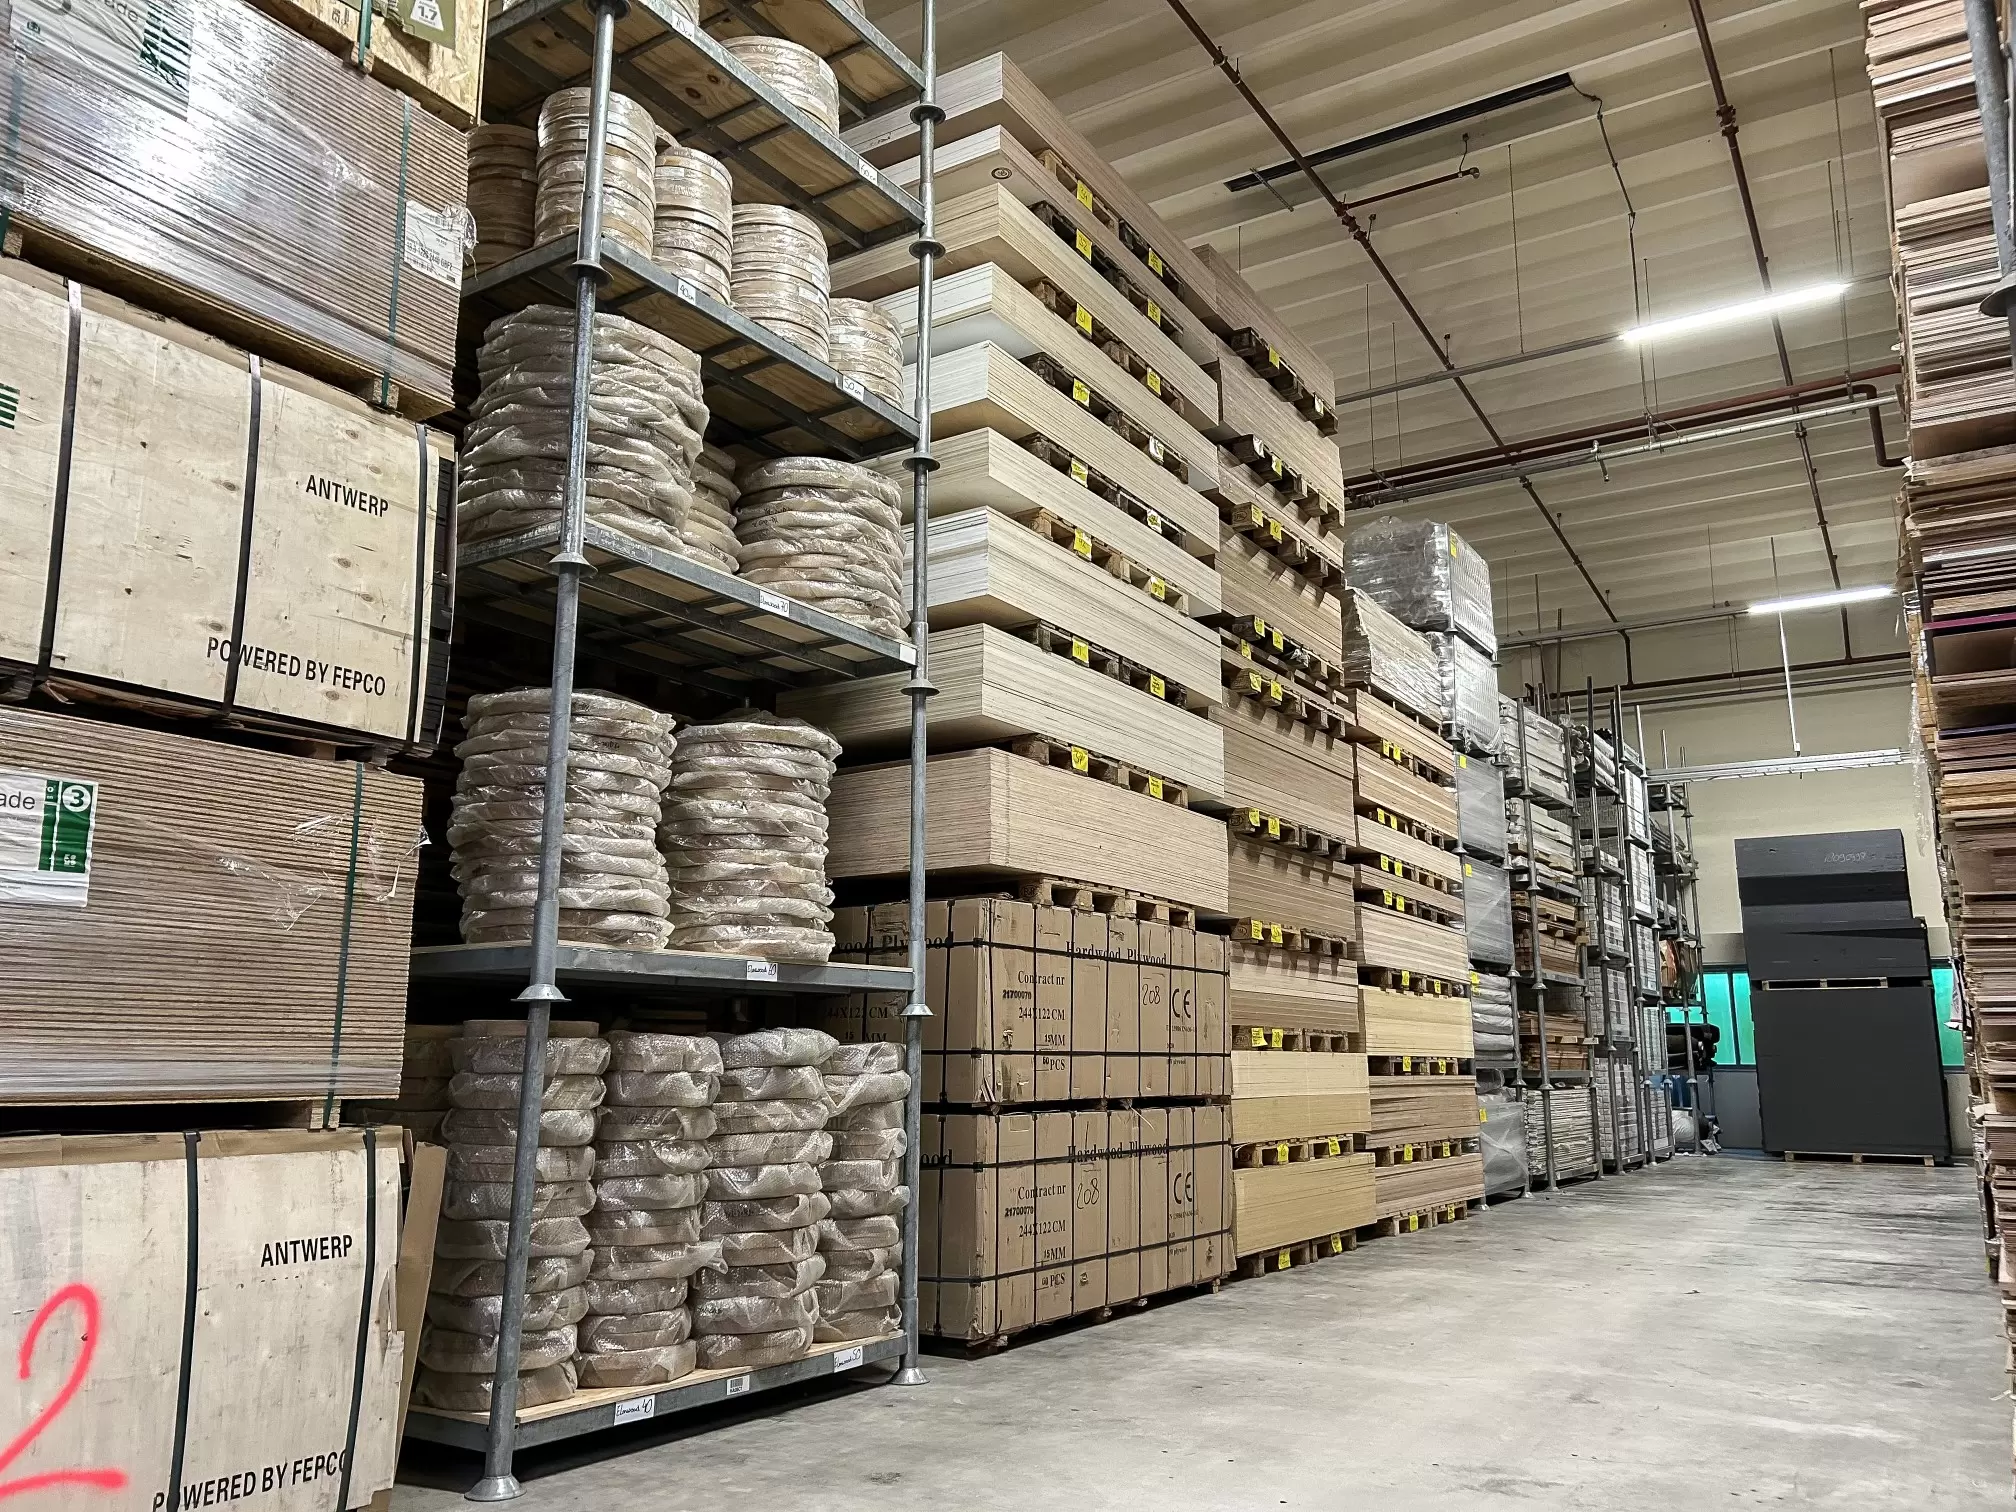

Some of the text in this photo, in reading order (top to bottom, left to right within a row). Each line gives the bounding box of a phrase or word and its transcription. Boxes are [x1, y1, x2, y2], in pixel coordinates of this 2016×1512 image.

[417, 5, 438, 21] 1.7
[305, 474, 389, 518] ANTWERP
[207, 636, 386, 697] POWERED BY FEPCO
[69, 789, 85, 808] 3
[1056, 976, 1066, 985] nr
[1142, 983, 1161, 1006] 208
[1052, 1008, 1066, 1021] CM
[1050, 1058, 1066, 1071] PCS
[1057, 1184, 1067, 1195] nr
[1052, 1219, 1066, 1233] CM
[260, 1234, 353, 1268] ANTWERP
[1050, 1272, 1066, 1287] PCS
[642, 1398, 653, 1414] 40
[261, 1463, 288, 1493] BY
